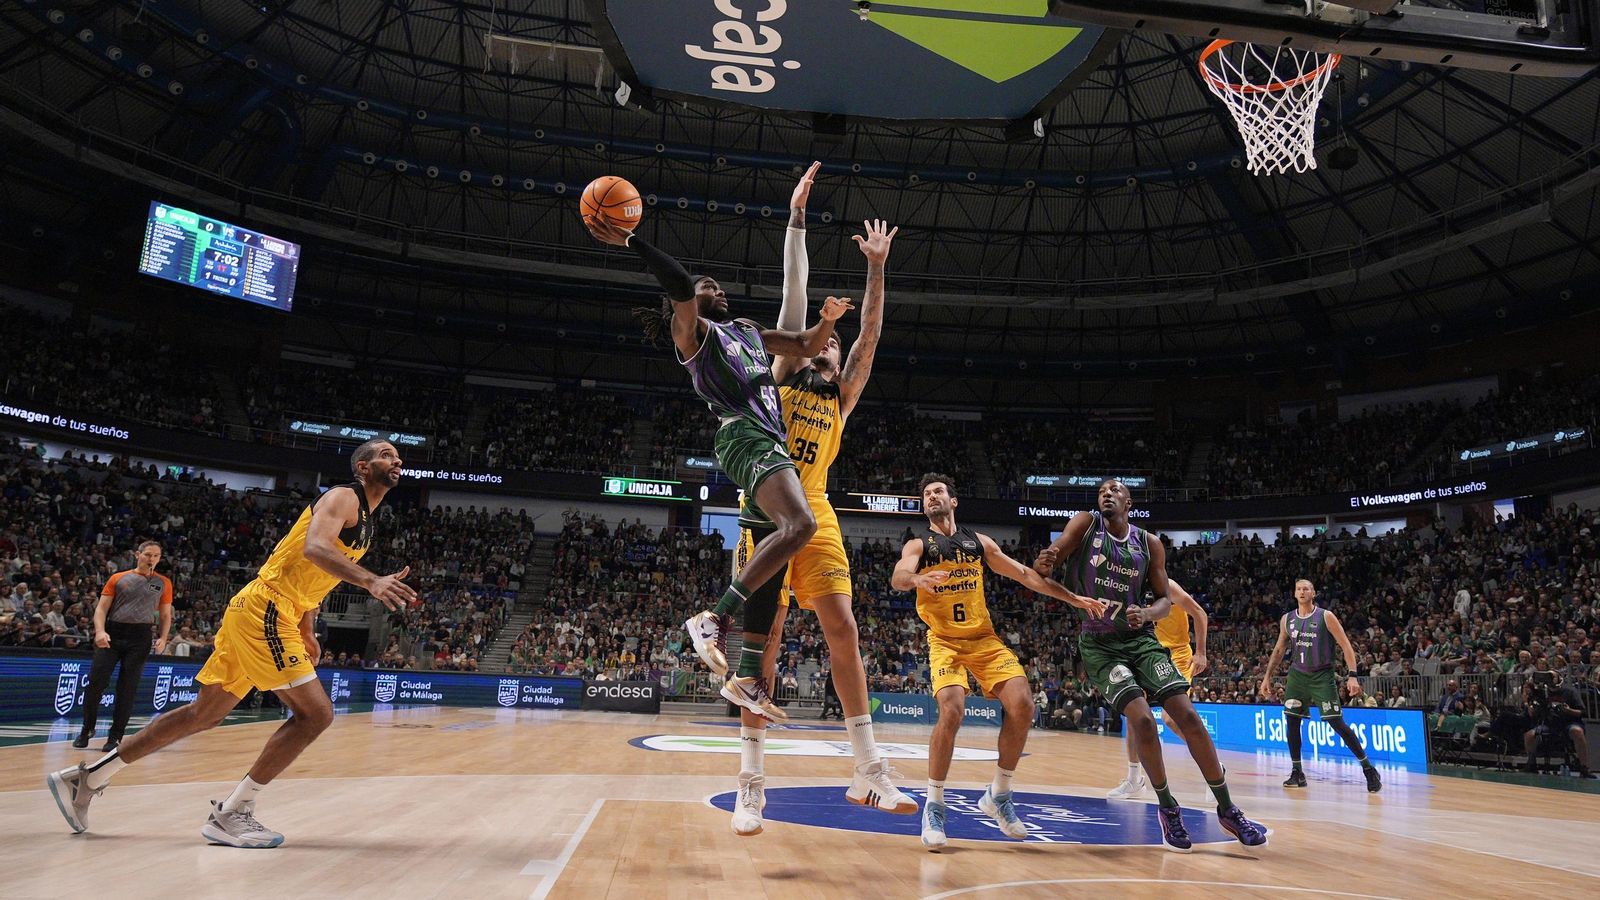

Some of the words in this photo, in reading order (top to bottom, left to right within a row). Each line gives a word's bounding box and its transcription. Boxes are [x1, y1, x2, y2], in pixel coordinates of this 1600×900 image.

[205, 222, 214, 232] 0
[243, 233, 252, 243] 7
[214, 251, 240, 267] 7:02
[228, 278, 236, 286] 0
[760, 385, 777, 411] 55
[52, 415, 67, 428] de
[70, 419, 87, 431] tus
[89, 424, 129, 440] sueños
[790, 437, 819, 465] 35
[436, 470, 449, 479] de
[452, 472, 466, 480] tus
[468, 474, 502, 484] sueños
[628, 482, 673, 496] UNICAJA
[700, 485, 709, 501] 0
[1350, 497, 1360, 507] El
[1361, 492, 1422, 506] Volkswagen
[1424, 488, 1436, 499] de
[1438, 486, 1452, 497] tus
[1454, 481, 1487, 495] sueños
[862, 496, 872, 504] LA
[872, 496, 900, 504] LAGUNA
[868, 502, 899, 512] TENERIFE
[1018, 506, 1027, 516] El
[1028, 507, 1080, 519] Volkswage
[1128, 508, 1150, 518] eños
[948, 568, 980, 578] AGUNA
[1106, 561, 1140, 578] Unicaja
[1094, 576, 1130, 593] málaga
[953, 602, 966, 622] 6
[1300, 652, 1304, 664] 1
[173, 675, 194, 687] Ciudad
[400, 680, 432, 690] Ciudad
[400, 690, 410, 698] de
[412, 690, 442, 701] Málaga
[523, 685, 553, 694] Ciudad
[586, 683, 653, 698] endesa
[78, 692, 85, 705] d
[170, 691, 178, 702] de
[522, 695, 533, 703] de
[534, 695, 564, 706] Málaga
[883, 704, 924, 718] Unicaja
[964, 706, 996, 720] nicaja
[1255, 709, 1266, 741] El
[1308, 720, 1335, 754] que
[1372, 724, 1406, 753] une
